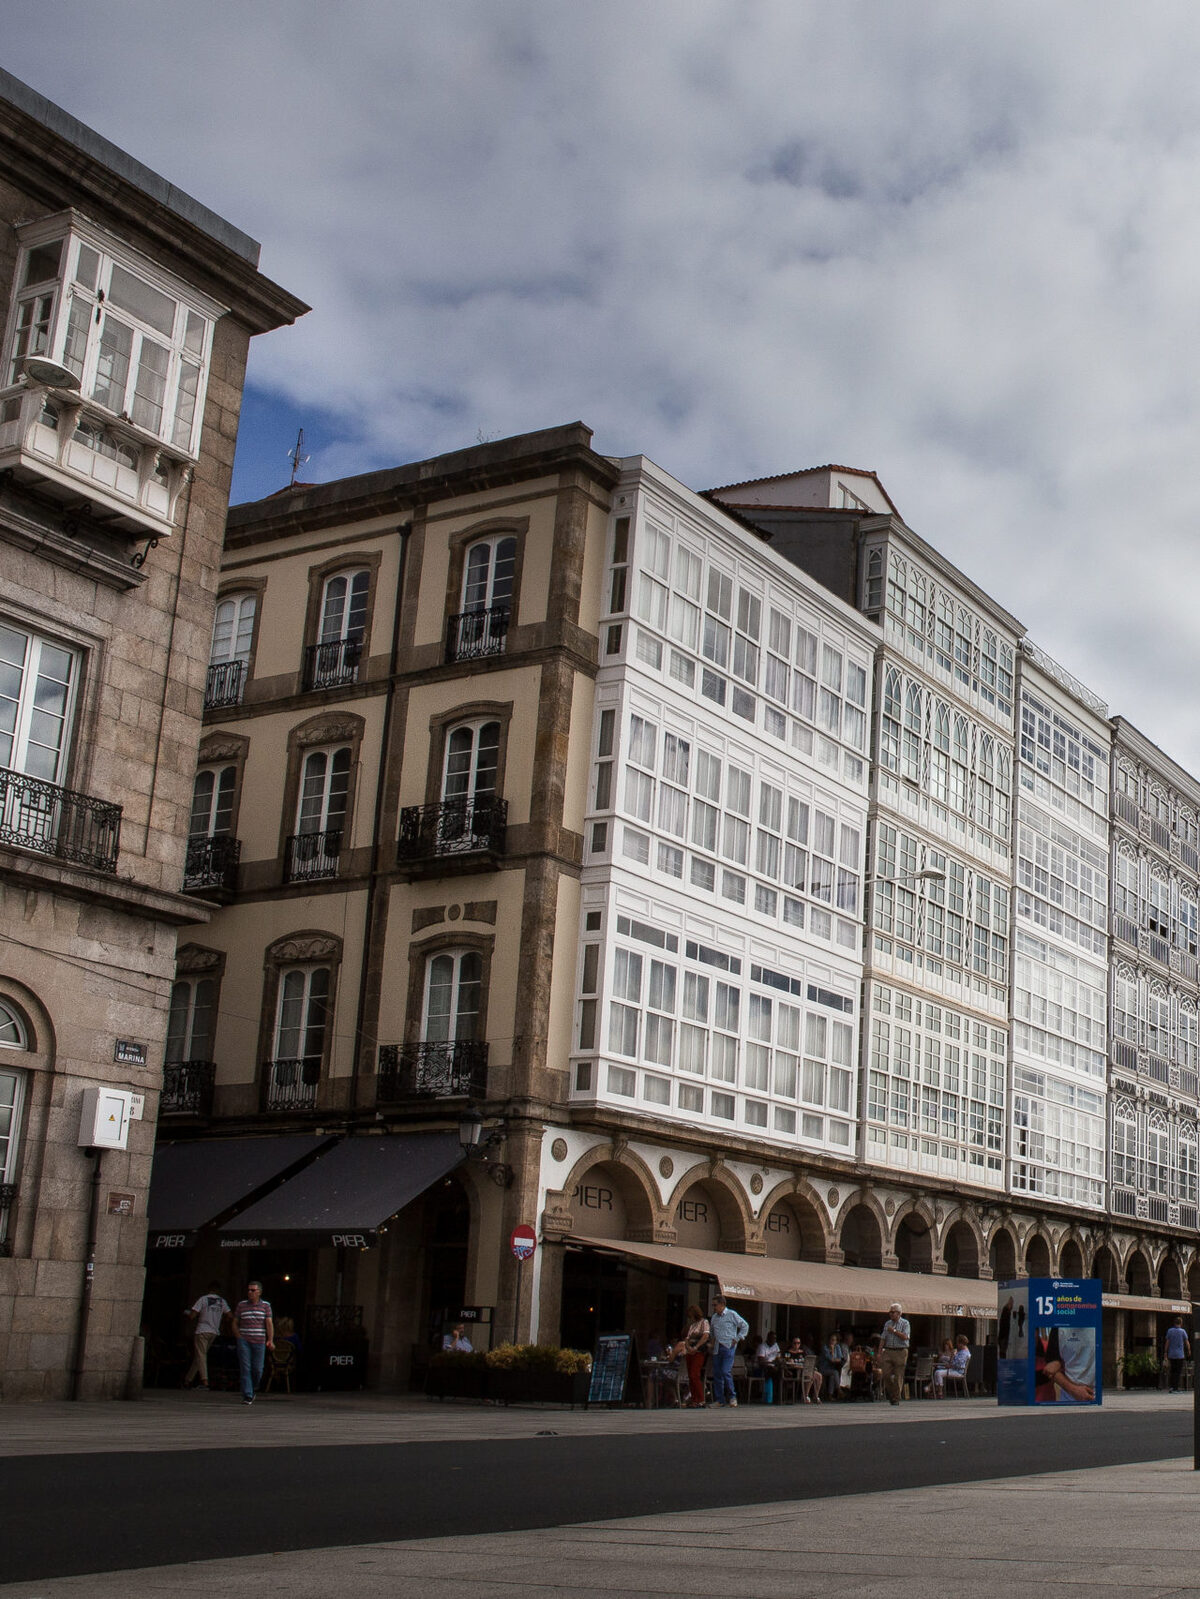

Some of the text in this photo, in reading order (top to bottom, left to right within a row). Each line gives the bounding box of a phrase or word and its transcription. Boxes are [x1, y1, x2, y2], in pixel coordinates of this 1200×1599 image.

[118, 1052, 145, 1064] MARINA
[676, 1201, 708, 1223] IER
[155, 1234, 186, 1248] PIER
[331, 1233, 367, 1247] PIER
[1056, 1294, 1083, 1303] años de
[1035, 1296, 1054, 1316] 15
[1056, 1308, 1076, 1316] social
[329, 1354, 354, 1366] PIER
